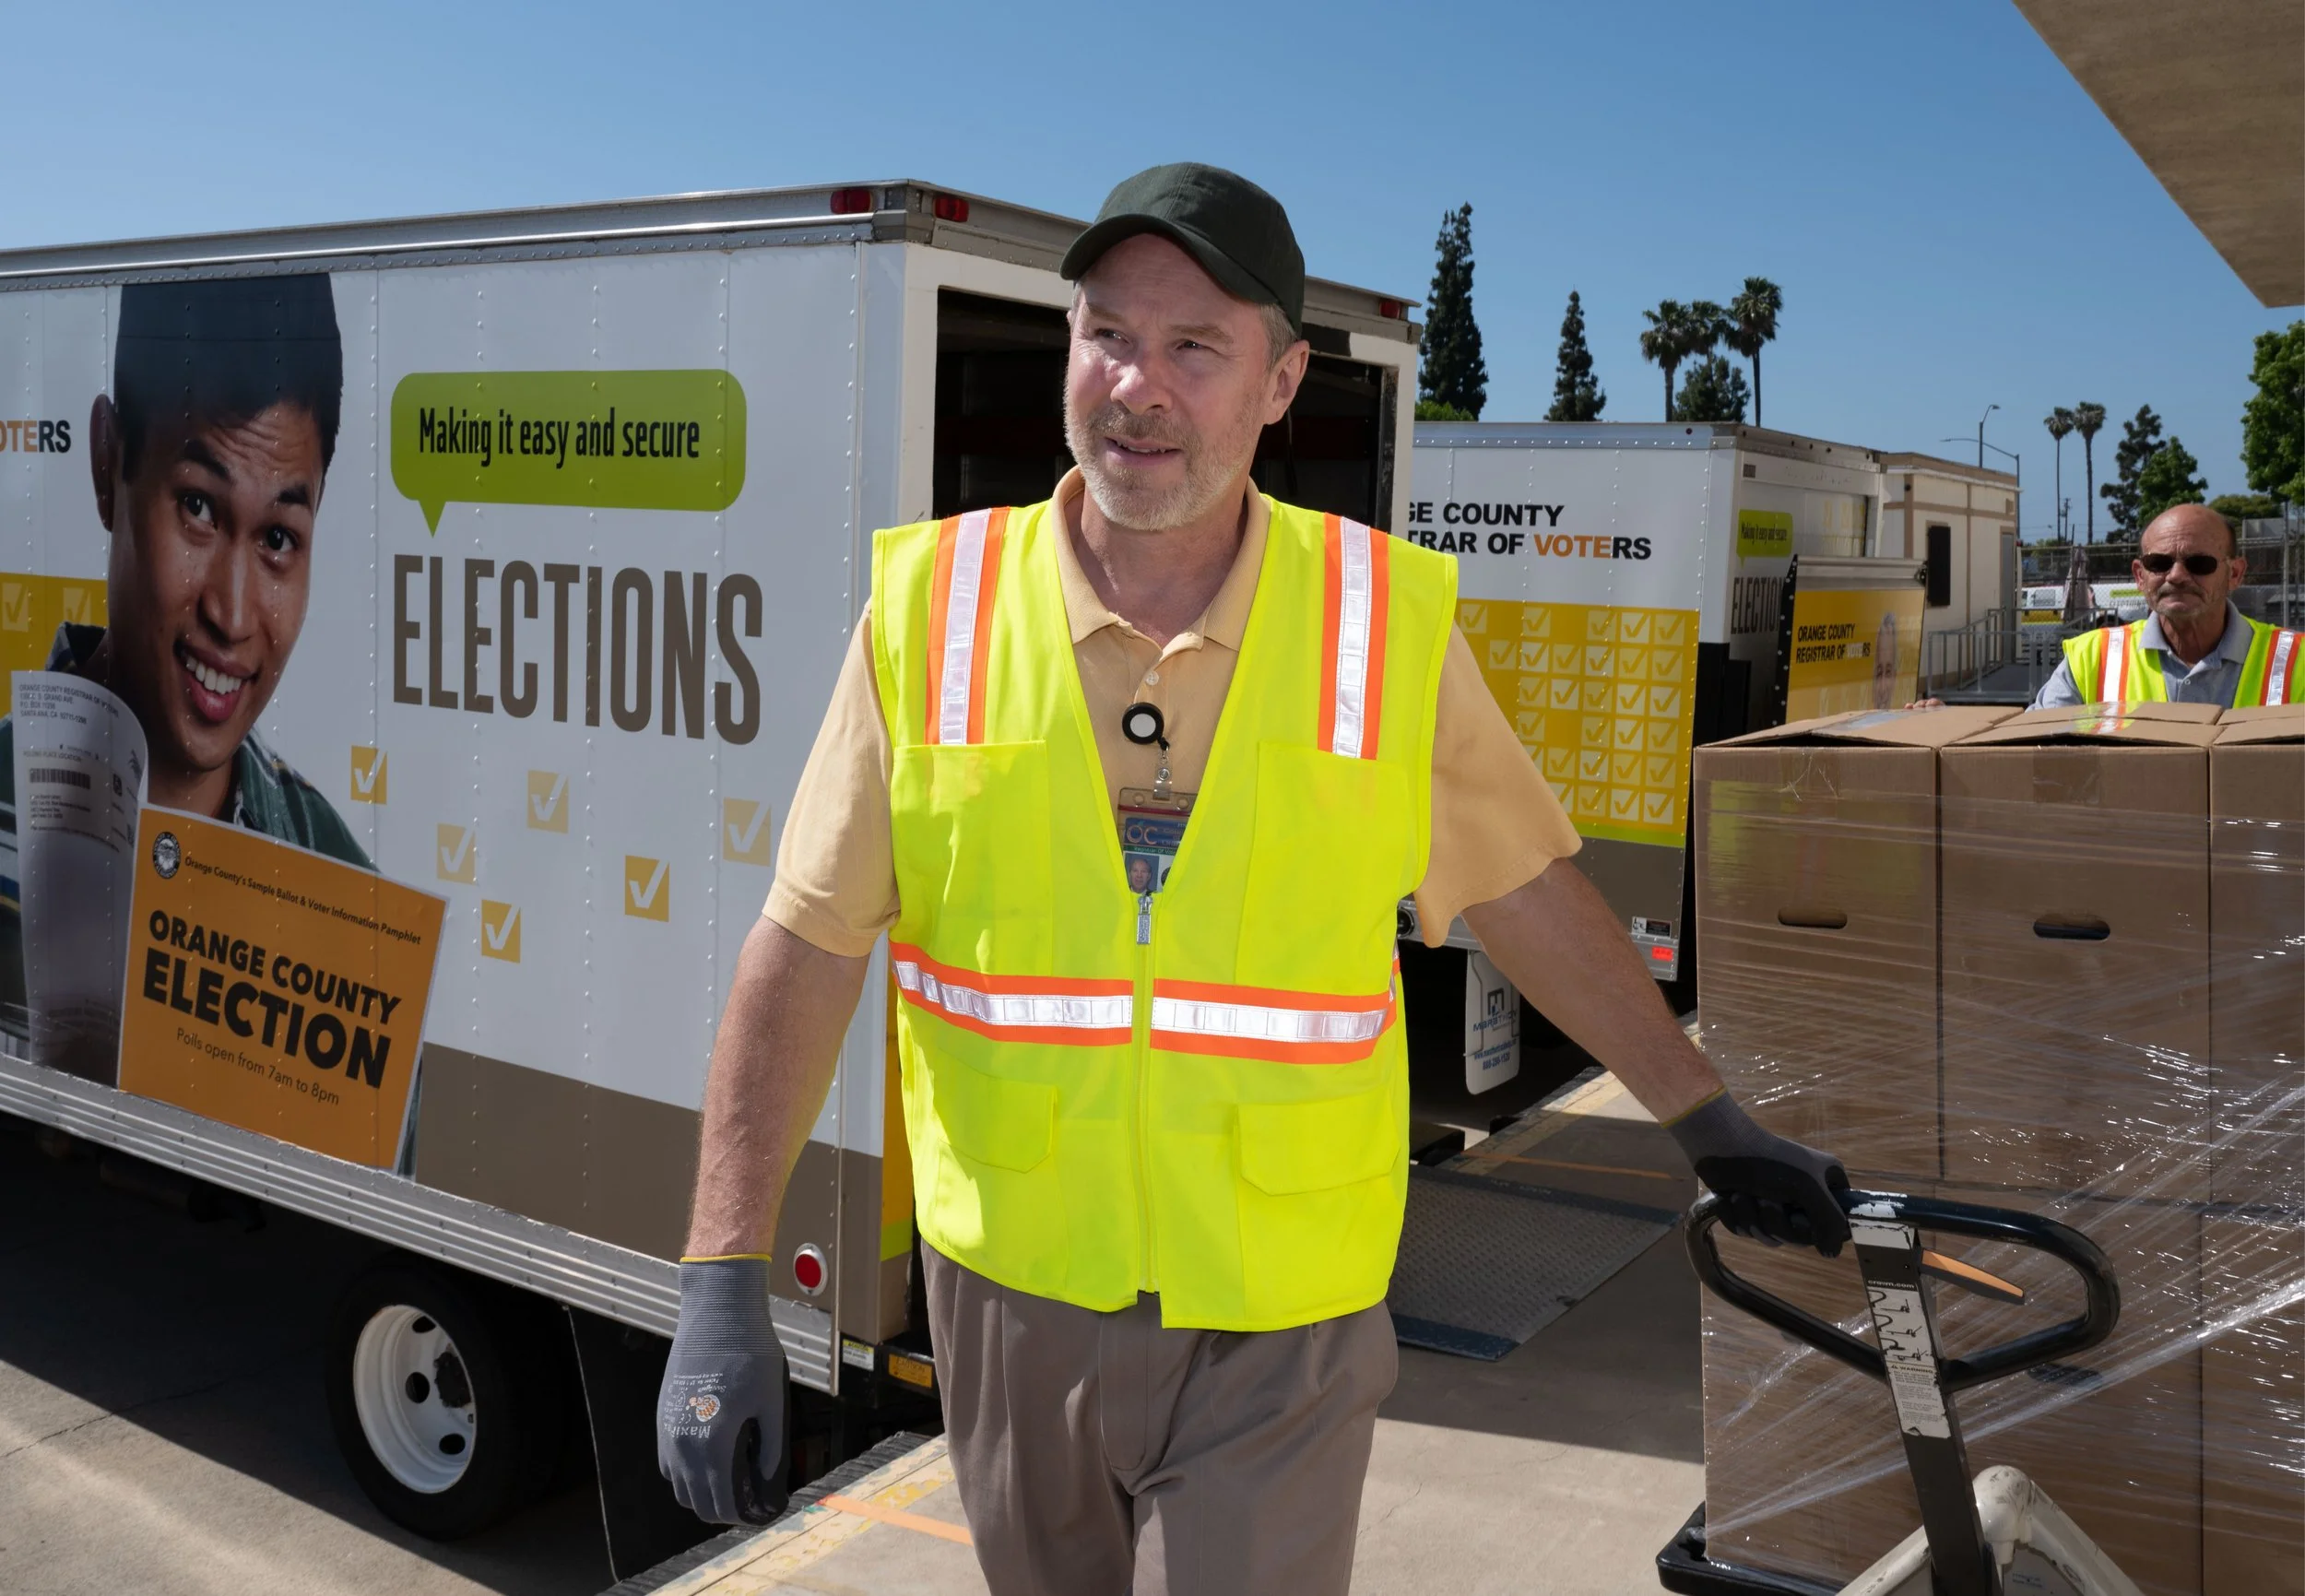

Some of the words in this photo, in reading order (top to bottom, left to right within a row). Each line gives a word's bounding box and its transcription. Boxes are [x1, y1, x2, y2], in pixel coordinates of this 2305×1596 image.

[419, 406, 492, 467] Making
[498, 408, 514, 455] it
[519, 418, 571, 469] easy
[575, 407, 615, 457] and
[622, 419, 700, 459] secure
[1443, 502, 1565, 526] COUNTY
[1487, 532, 1525, 555] OF
[1533, 534, 1652, 561] VOTERS
[394, 553, 763, 746] ELECTIONS
[1796, 644, 1836, 663] REGISTRAR
[1837, 644, 1846, 659] OF
[1797, 625, 1826, 643] ORANGE
[1827, 623, 1856, 640] COUNTY
[1127, 824, 1158, 845] OC
[184, 857, 213, 874] Orange
[213, 866, 246, 886] County's
[247, 877, 276, 896] Sample
[276, 887, 299, 904] Ballot
[300, 895, 307, 906] &
[308, 899, 331, 915] Voter
[331, 906, 379, 931] Information
[380, 922, 421, 945] Pamphlet
[149, 910, 266, 978] ORANGE
[271, 955, 402, 1025] COUNTY
[143, 947, 392, 1090] ELECTION
[177, 1027, 203, 1050] Polls
[205, 1043, 235, 1065] open
[236, 1051, 265, 1077] from
[267, 1064, 293, 1088] 7am
[296, 1078, 308, 1094] to
[311, 1082, 339, 1105] 8pm
[1867, 1279, 1915, 1289] crown.com
